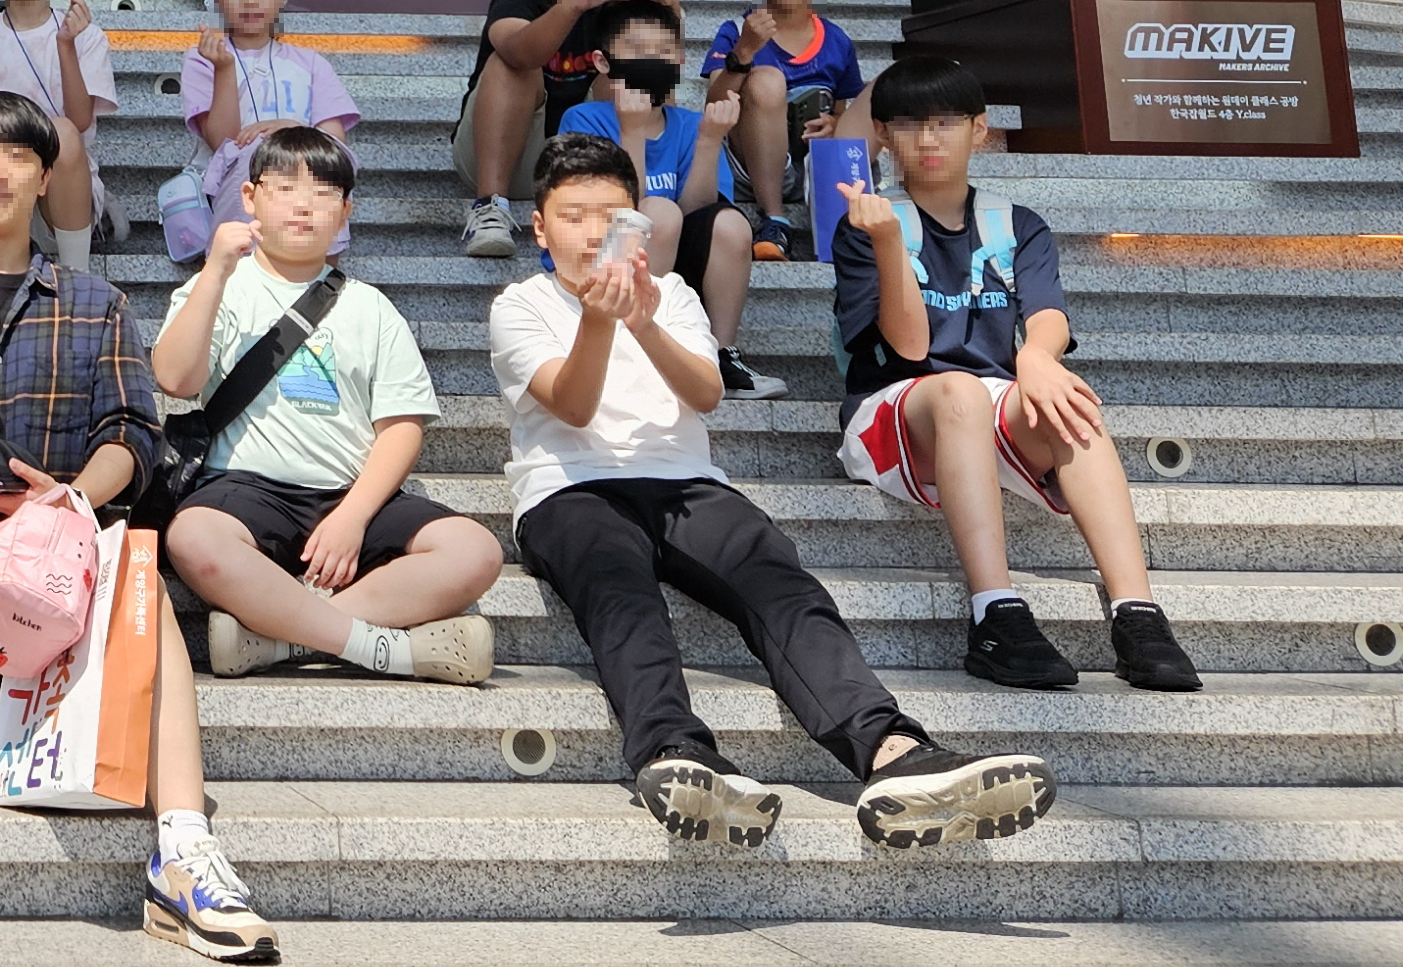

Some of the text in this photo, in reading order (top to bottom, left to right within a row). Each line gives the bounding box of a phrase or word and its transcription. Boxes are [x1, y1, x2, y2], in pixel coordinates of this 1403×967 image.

[1124, 22, 1295, 61] MAKIVE
[1219, 63, 1290, 73] MAKERS ARCHIVE
